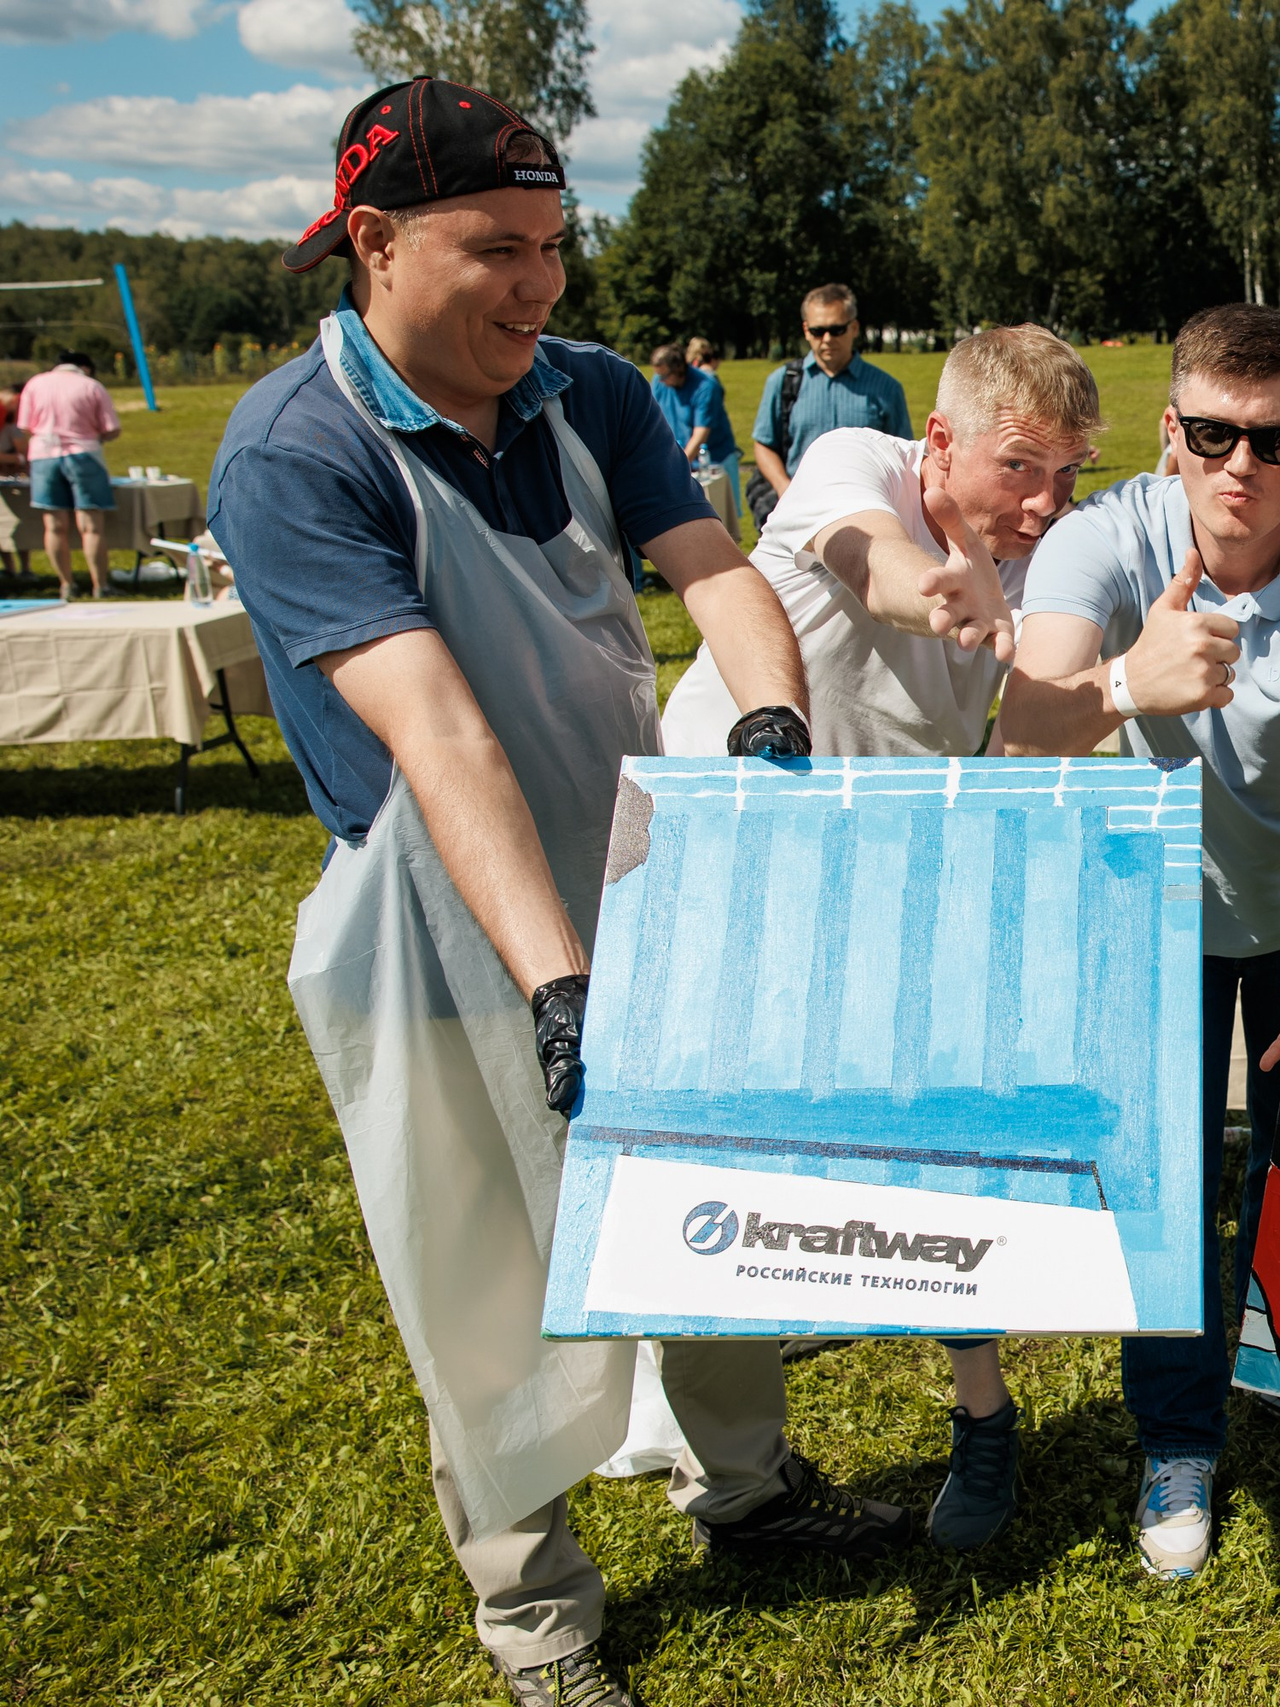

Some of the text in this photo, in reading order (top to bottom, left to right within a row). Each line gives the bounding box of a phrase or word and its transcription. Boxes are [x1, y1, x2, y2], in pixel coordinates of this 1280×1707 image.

[514, 170, 559, 183] HONDA
[741, 1211, 994, 1273] kraftway
[736, 1264, 978, 1296] РОССИЙСКИЕ ТЕХНОЛОГИИ
